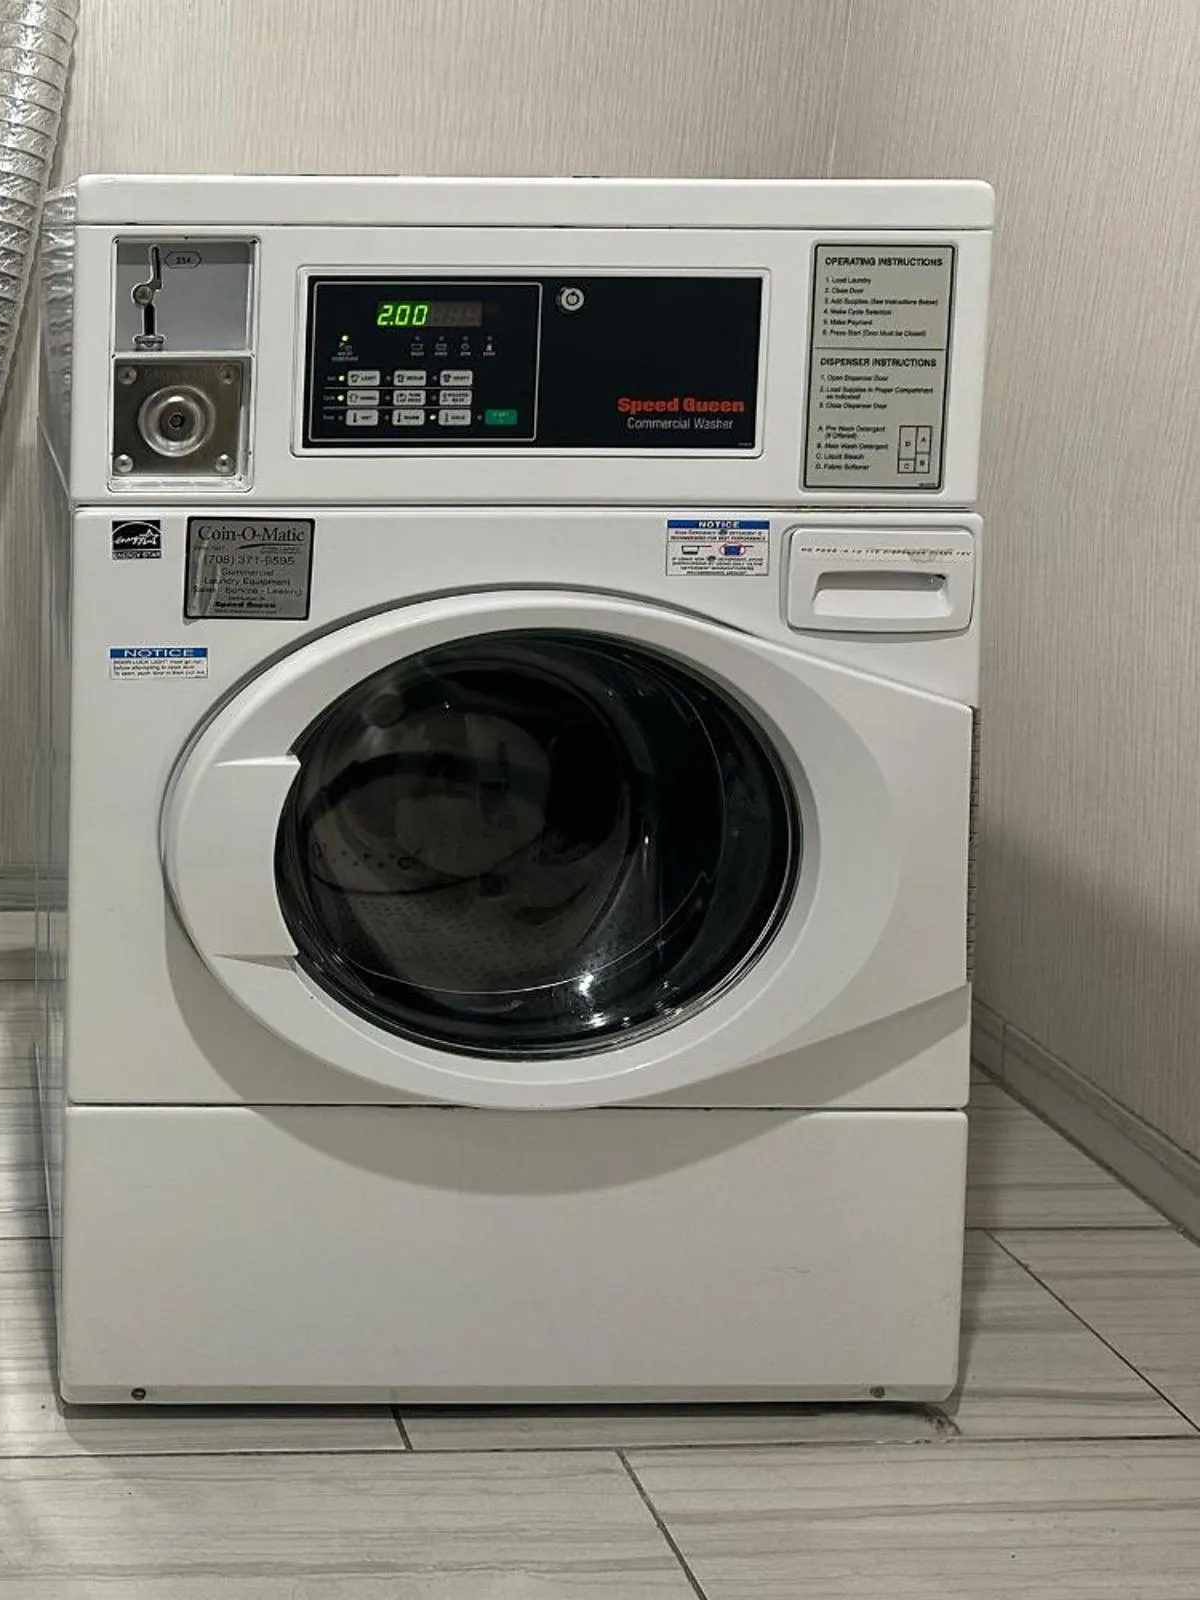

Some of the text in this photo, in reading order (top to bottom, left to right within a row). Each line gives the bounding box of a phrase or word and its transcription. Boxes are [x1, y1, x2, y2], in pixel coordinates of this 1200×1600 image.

[825, 257, 943, 266] OPERATING INSTRUCTIONS
[376, 305, 429, 326] 2.00
[820, 358, 936, 367] DISPENSER INSTRUCTIONS
[617, 397, 744, 415] Speed Queen
[627, 416, 734, 430] Commercial Washer
[198, 526, 305, 542] Coin-O-Matic
[222, 568, 274, 576] Commercial
[204, 576, 290, 586] Laundry Equipment
[124, 649, 194, 657] NOTICE
